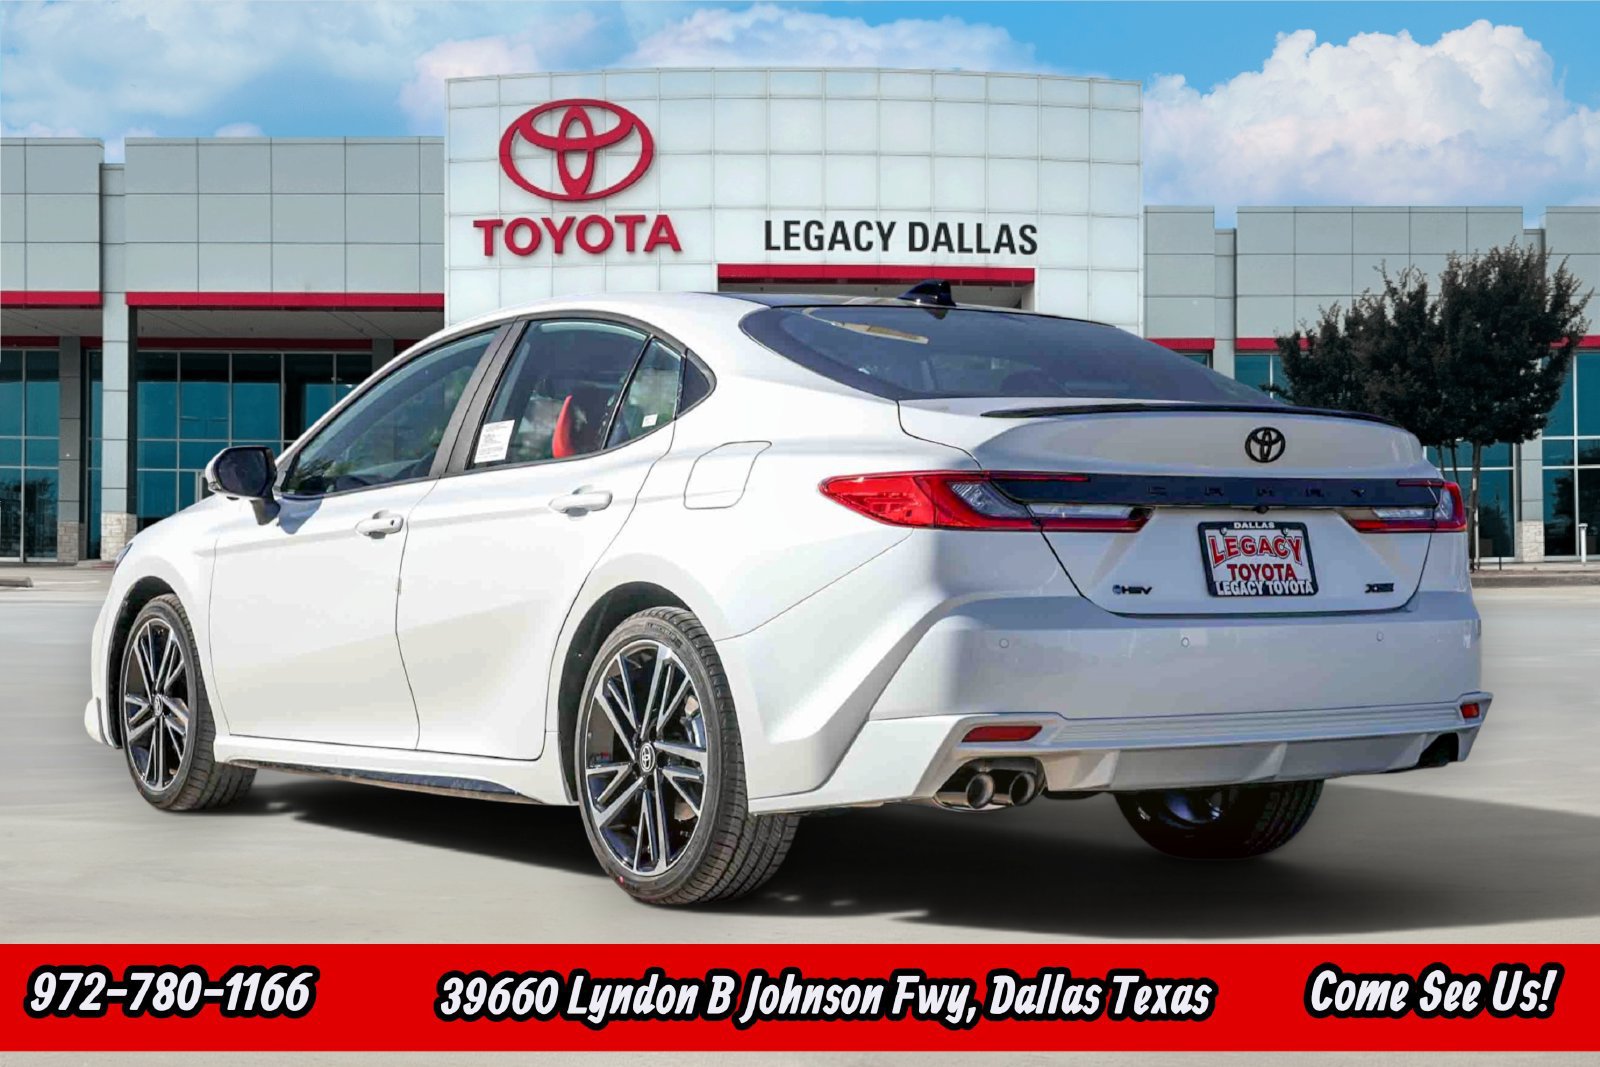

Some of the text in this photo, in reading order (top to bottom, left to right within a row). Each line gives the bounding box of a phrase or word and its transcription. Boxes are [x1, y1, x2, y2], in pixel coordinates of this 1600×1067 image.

[474, 214, 681, 256] TOYOTA
[764, 220, 1039, 255] LEGACY DALLAS
[1233, 521, 1275, 529] DALLAS
[1208, 535, 1303, 567] LEGACY
[1227, 563, 1298, 581] TOYOTA
[1215, 579, 1314, 595] LEGACY TOYOTA
